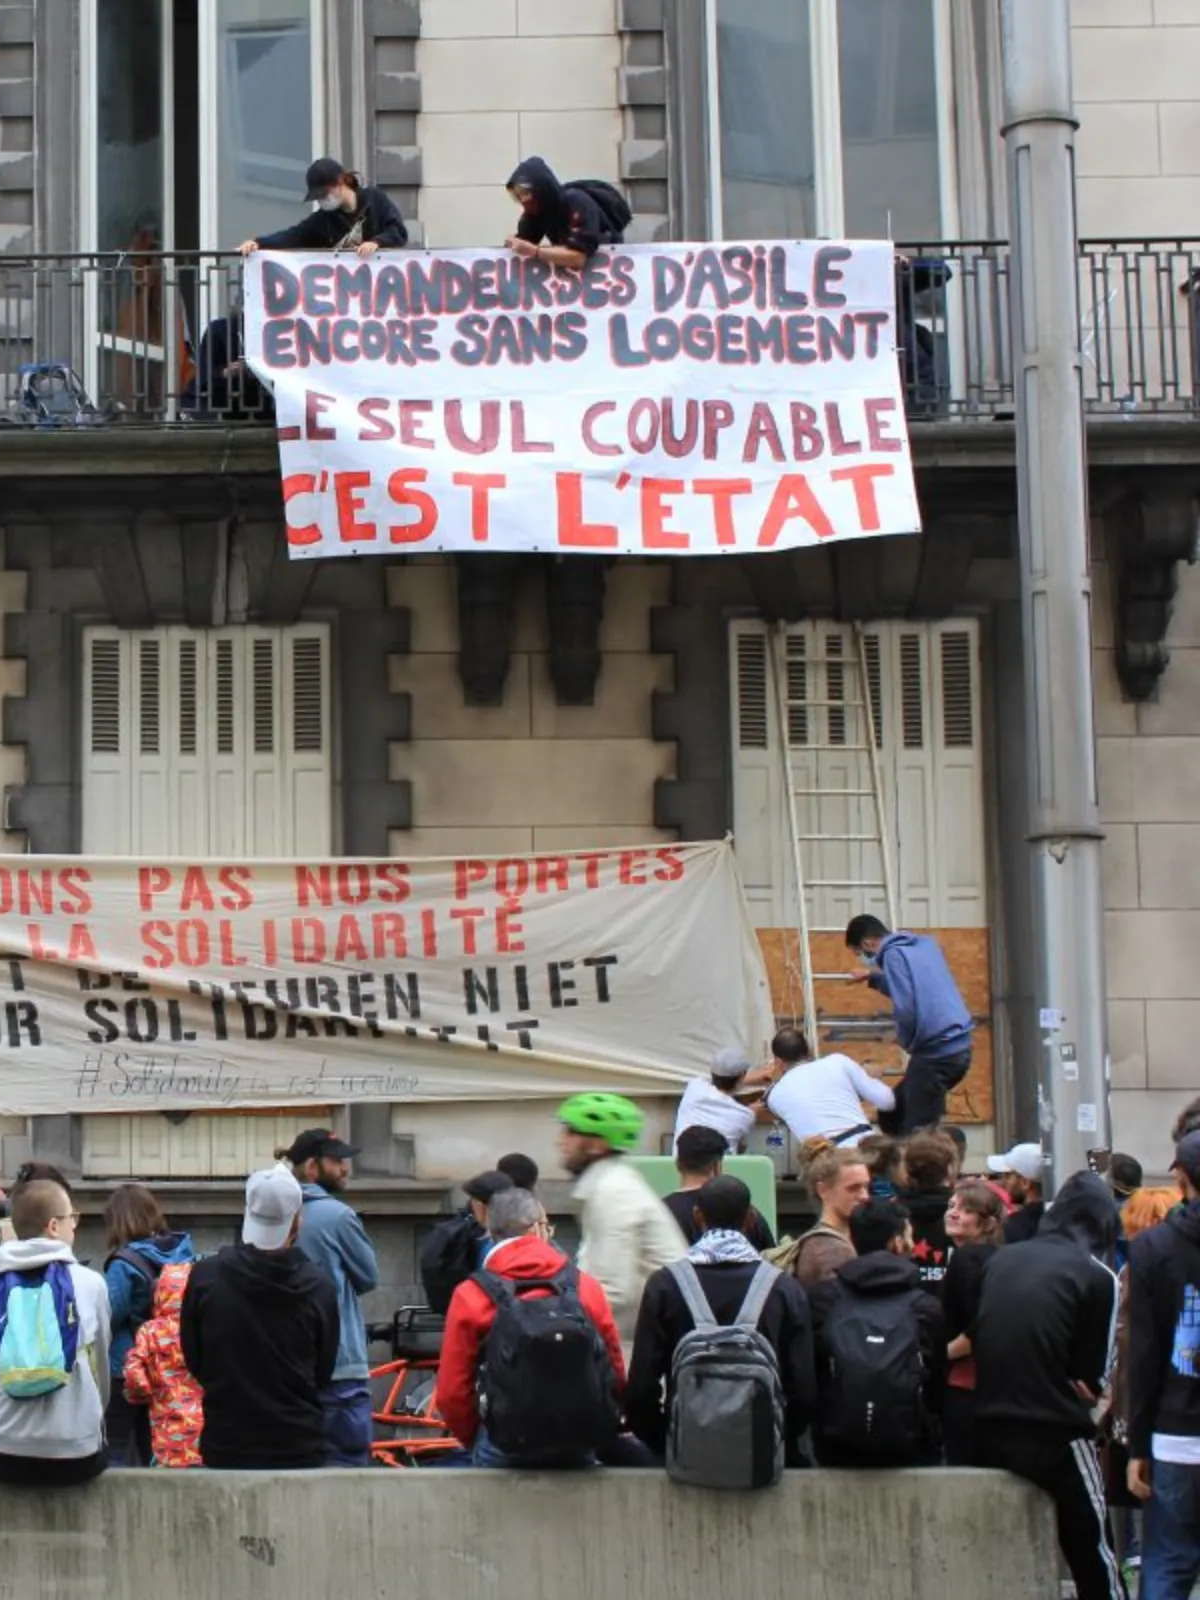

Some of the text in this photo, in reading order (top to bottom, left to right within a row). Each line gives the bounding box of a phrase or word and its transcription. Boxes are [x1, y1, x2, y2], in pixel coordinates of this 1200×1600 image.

[261, 311, 890, 369] ENCORE SANS LOGEMENT
[358, 397, 555, 455] SEUL
[581, 397, 903, 463] COUPABLE
[283, 463, 895, 549] C'EST L'ETAT
[138, 865, 254, 912] PAS
[294, 863, 412, 907] NOS
[454, 846, 685, 899] PORTES
[27, 923, 99, 961] LA
[141, 898, 526, 968] SOLIDARITÉ
[462, 955, 618, 1014] NIET
